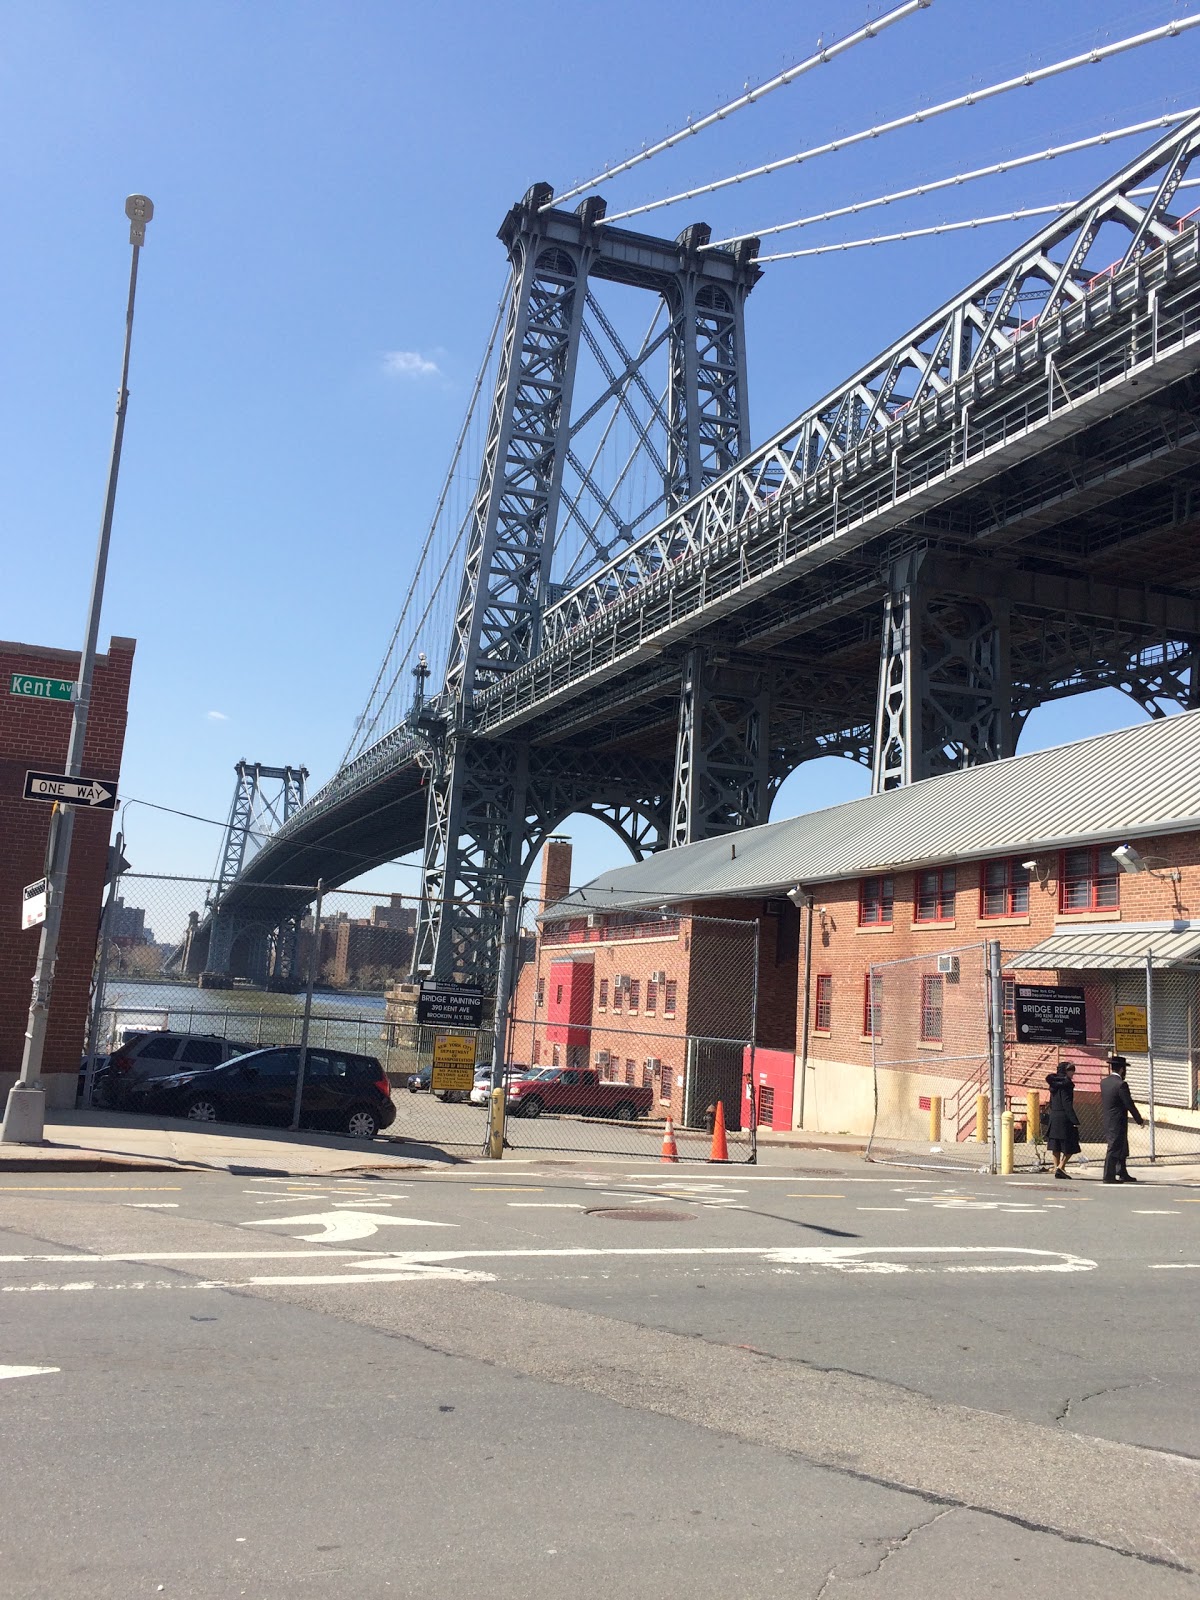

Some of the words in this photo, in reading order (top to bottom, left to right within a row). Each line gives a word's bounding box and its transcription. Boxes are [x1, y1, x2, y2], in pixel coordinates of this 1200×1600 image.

[12, 676, 52, 696] Kent
[59, 684, 72, 692] Av
[39, 782, 66, 794] ONE
[77, 786, 104, 799] WAY
[422, 994, 446, 1003] BRIDGE
[450, 996, 480, 1006] PAINTING
[1022, 1004, 1052, 1013] BRIDGE
[1054, 1006, 1080, 1014] REPAIR
